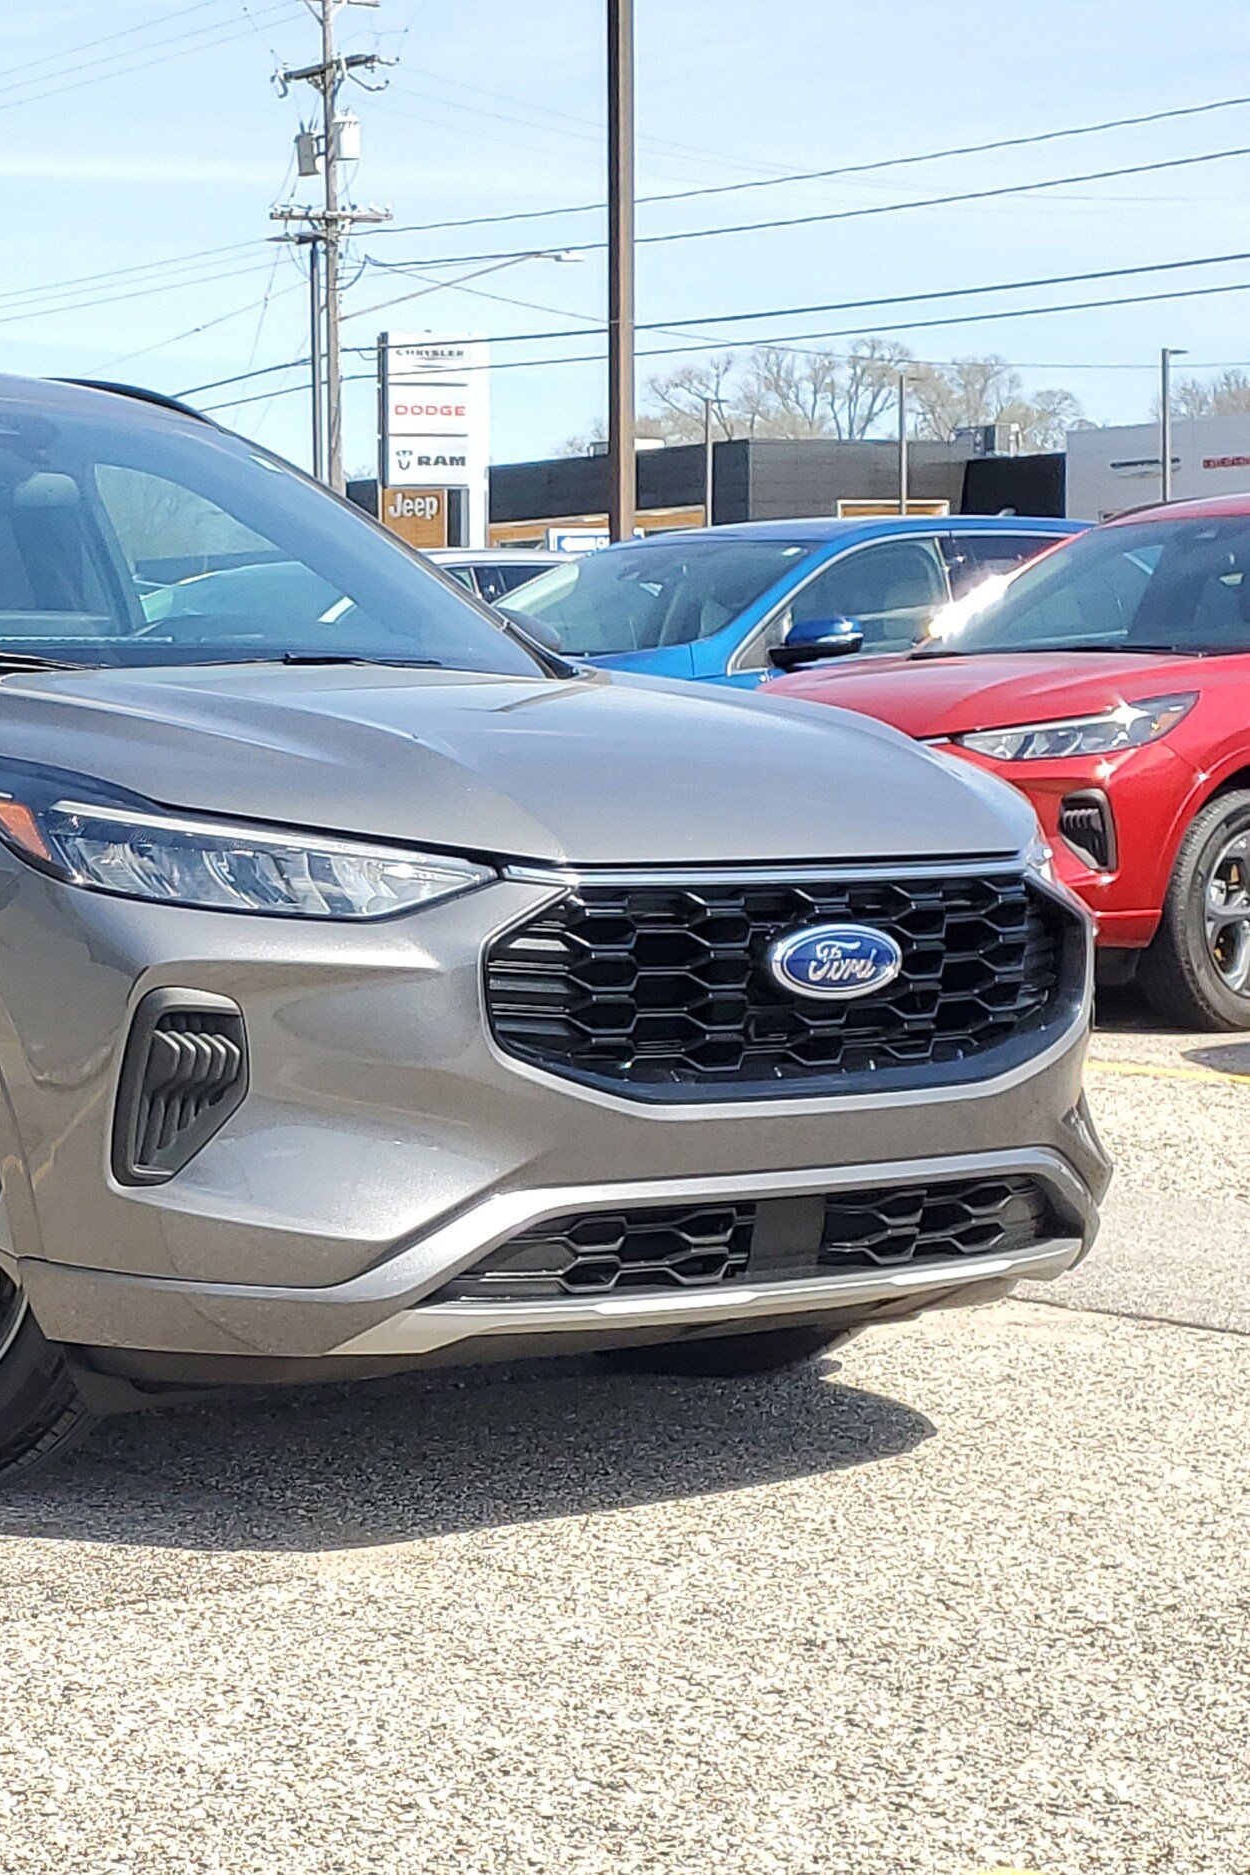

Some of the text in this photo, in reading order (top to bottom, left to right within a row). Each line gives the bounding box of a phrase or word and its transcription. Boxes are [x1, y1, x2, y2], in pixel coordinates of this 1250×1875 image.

[394, 404, 466, 416] DODGE
[417, 455, 466, 467] RAM
[388, 492, 438, 520] Jeep
[808, 939, 878, 982] Ford
